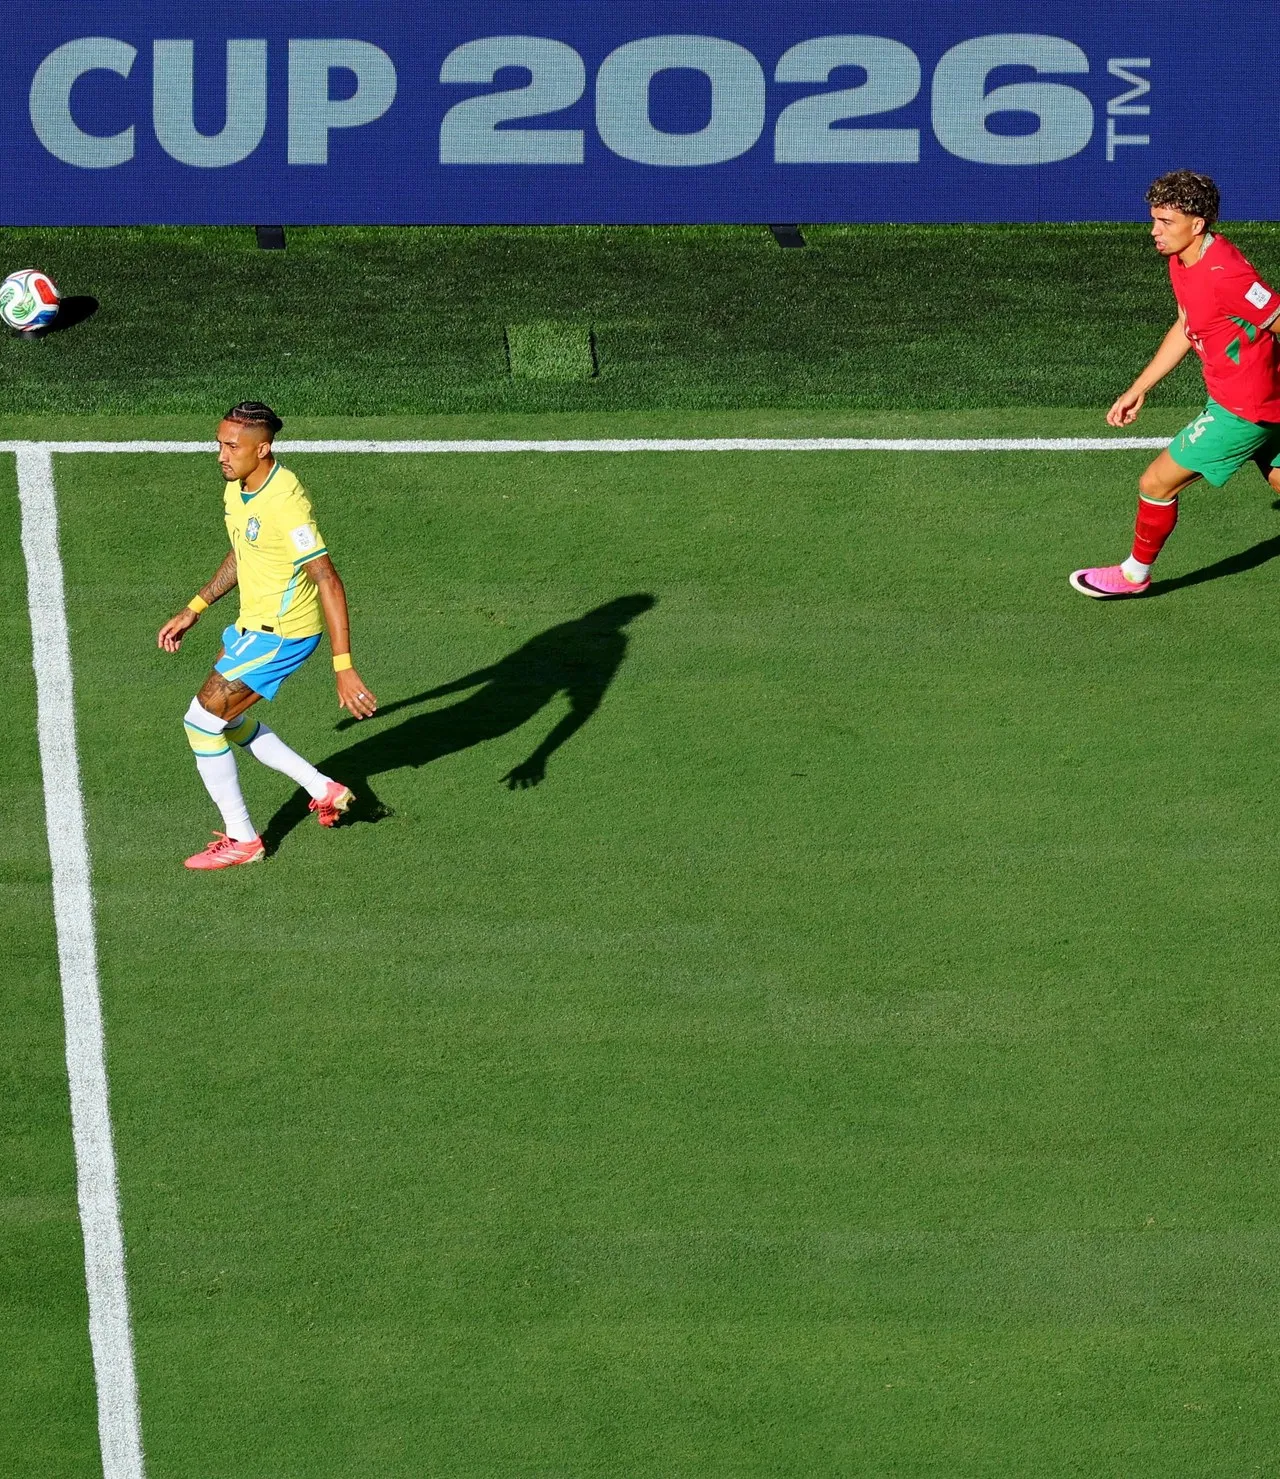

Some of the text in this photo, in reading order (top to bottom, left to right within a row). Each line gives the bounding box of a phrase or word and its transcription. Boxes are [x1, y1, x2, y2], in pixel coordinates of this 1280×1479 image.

[28, 36, 397, 168] CUP
[439, 33, 1096, 167] 2026
[1105, 57, 1151, 161] TM
